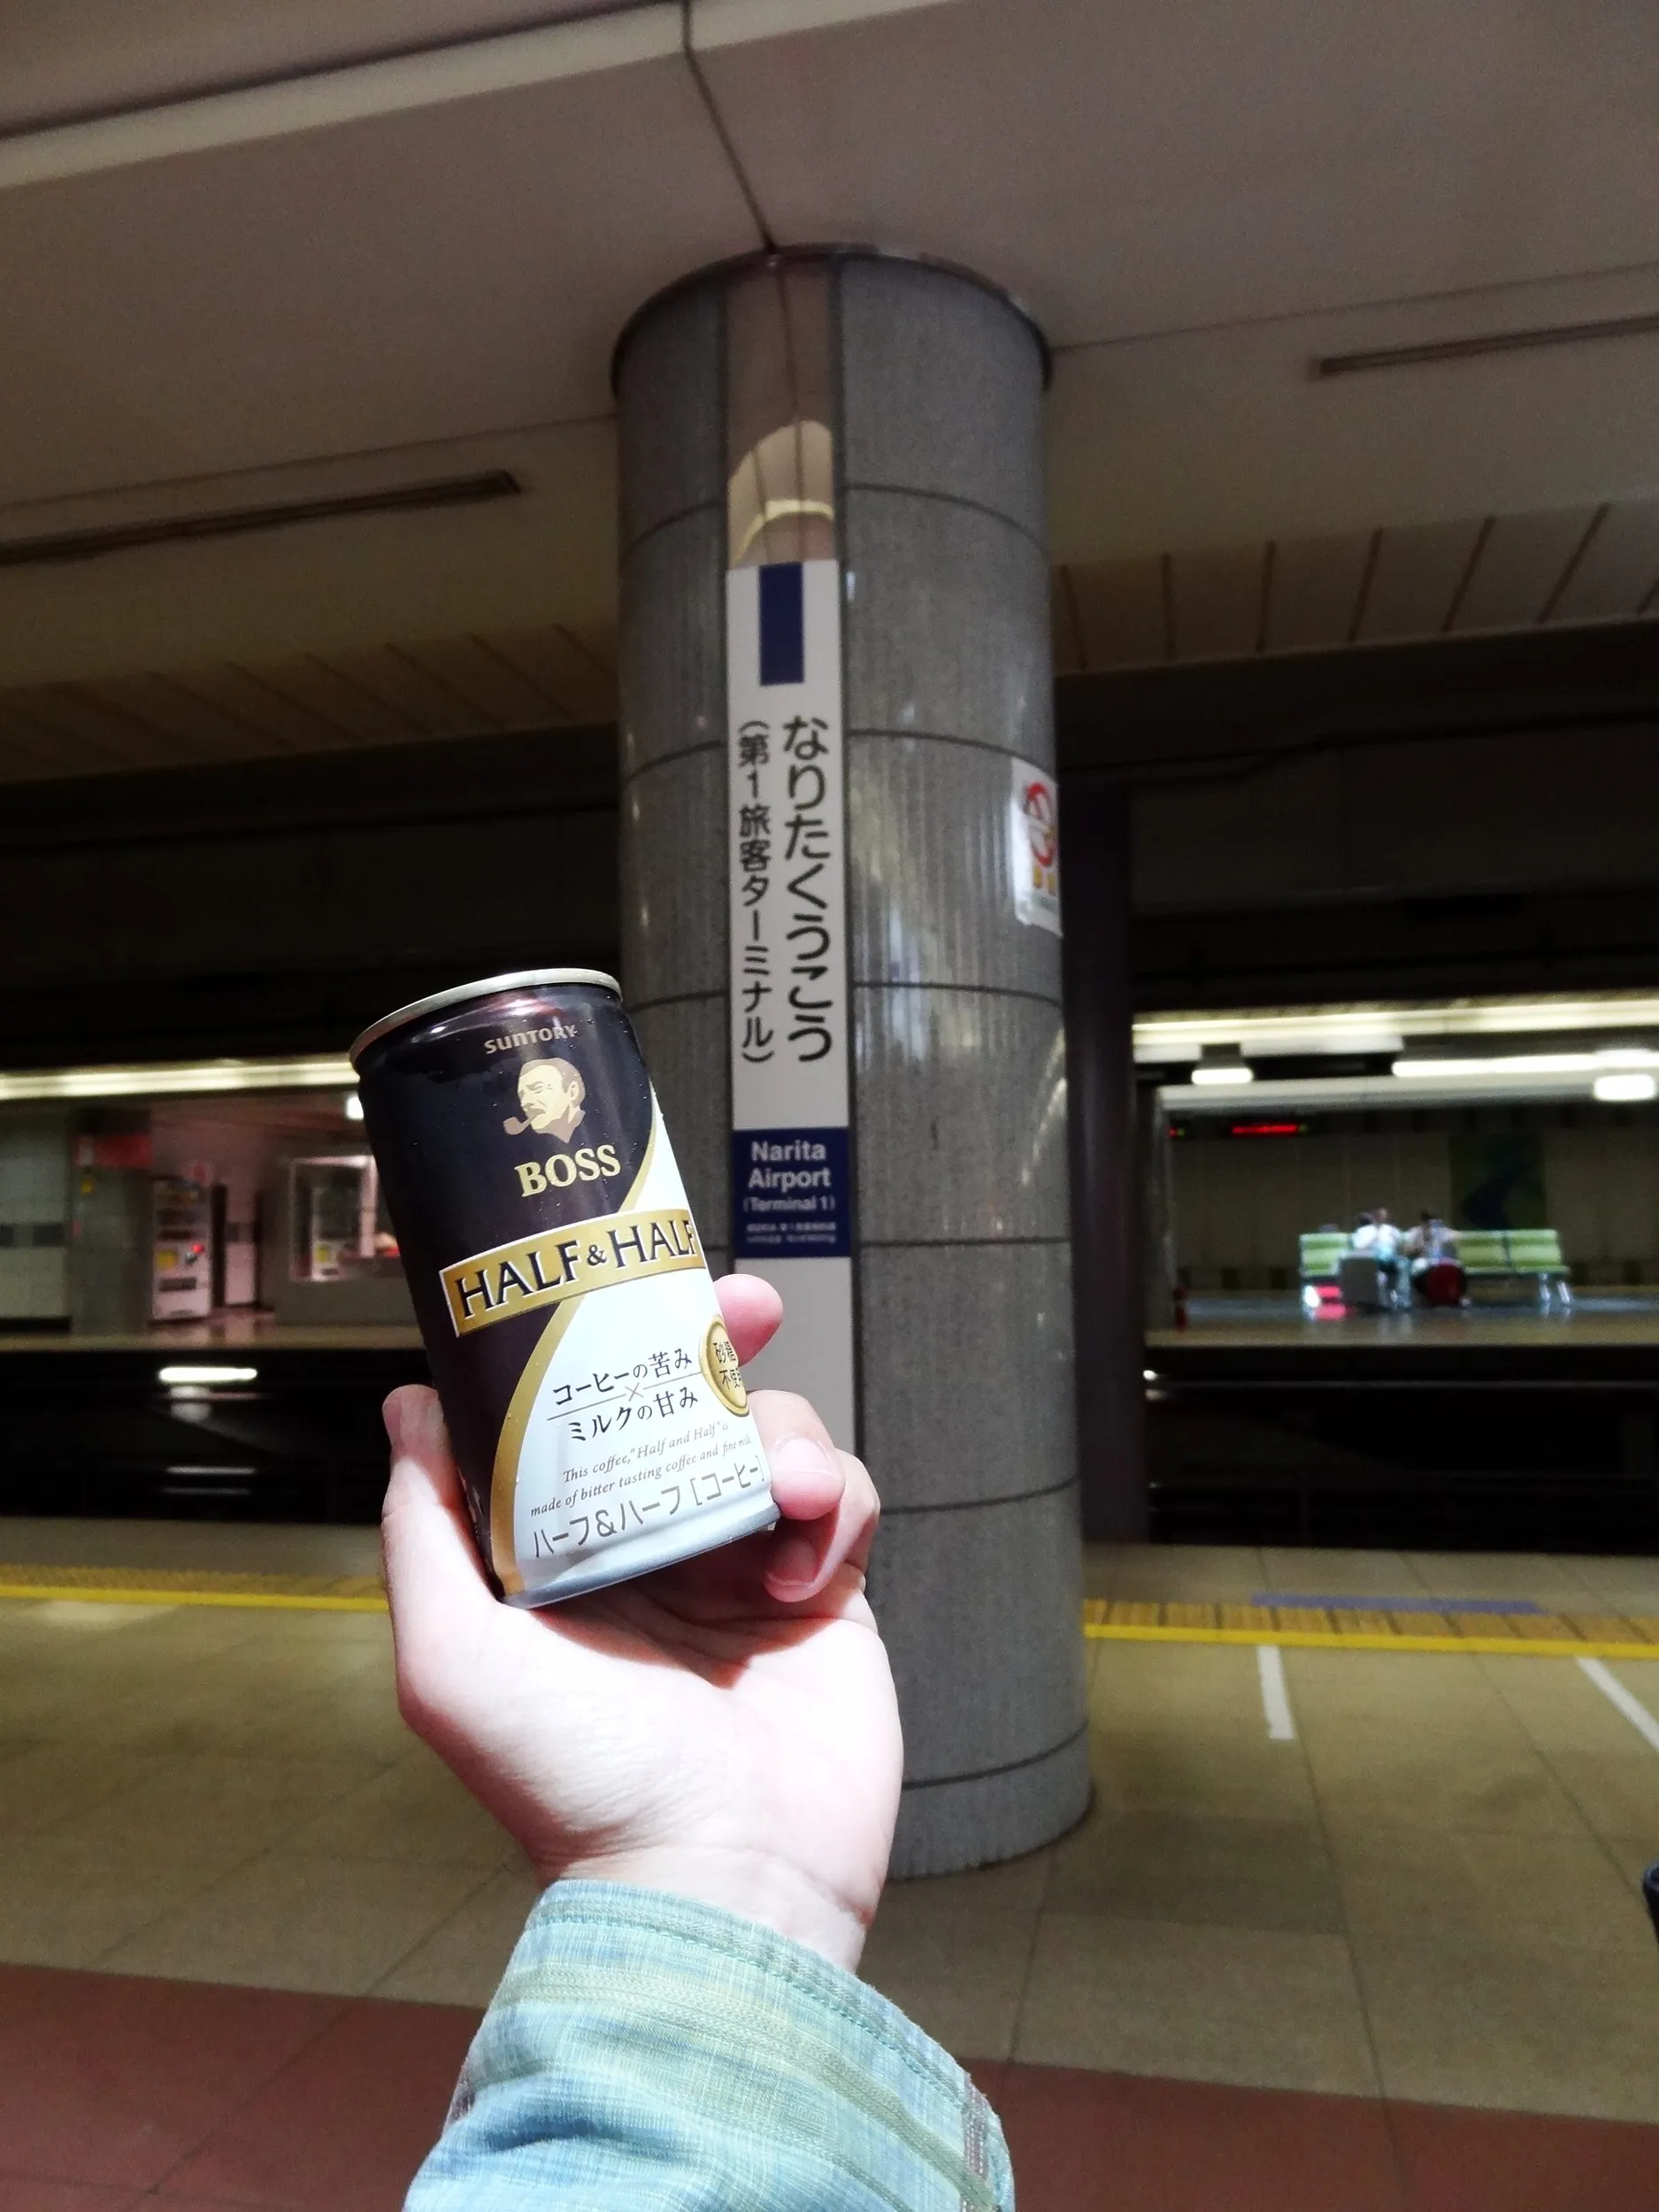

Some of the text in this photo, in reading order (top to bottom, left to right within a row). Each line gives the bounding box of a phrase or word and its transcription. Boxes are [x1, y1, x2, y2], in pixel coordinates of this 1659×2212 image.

[783, 715, 833, 1061] なりたくうこう
[484, 1025, 577, 1055] SUNTORY
[513, 1144, 621, 1197] BOSS
[750, 1139, 827, 1162] Narita
[748, 1167, 832, 1194] Airport
[552, 1348, 692, 1406] コーヒーの苦み
[568, 1386, 698, 1442] ミルクの甘み
[531, 1497, 562, 1517] made
[565, 1490, 578, 1509] of
[580, 1480, 616, 1501] bitter
[619, 1465, 662, 1488] tasting
[665, 1453, 697, 1473] coffee
[700, 1443, 718, 1461] and
[722, 1440, 737, 1458] fine
[563, 1468, 588, 1484] This
[669, 1430, 690, 1448] and
[722, 1422, 729, 1431] is
